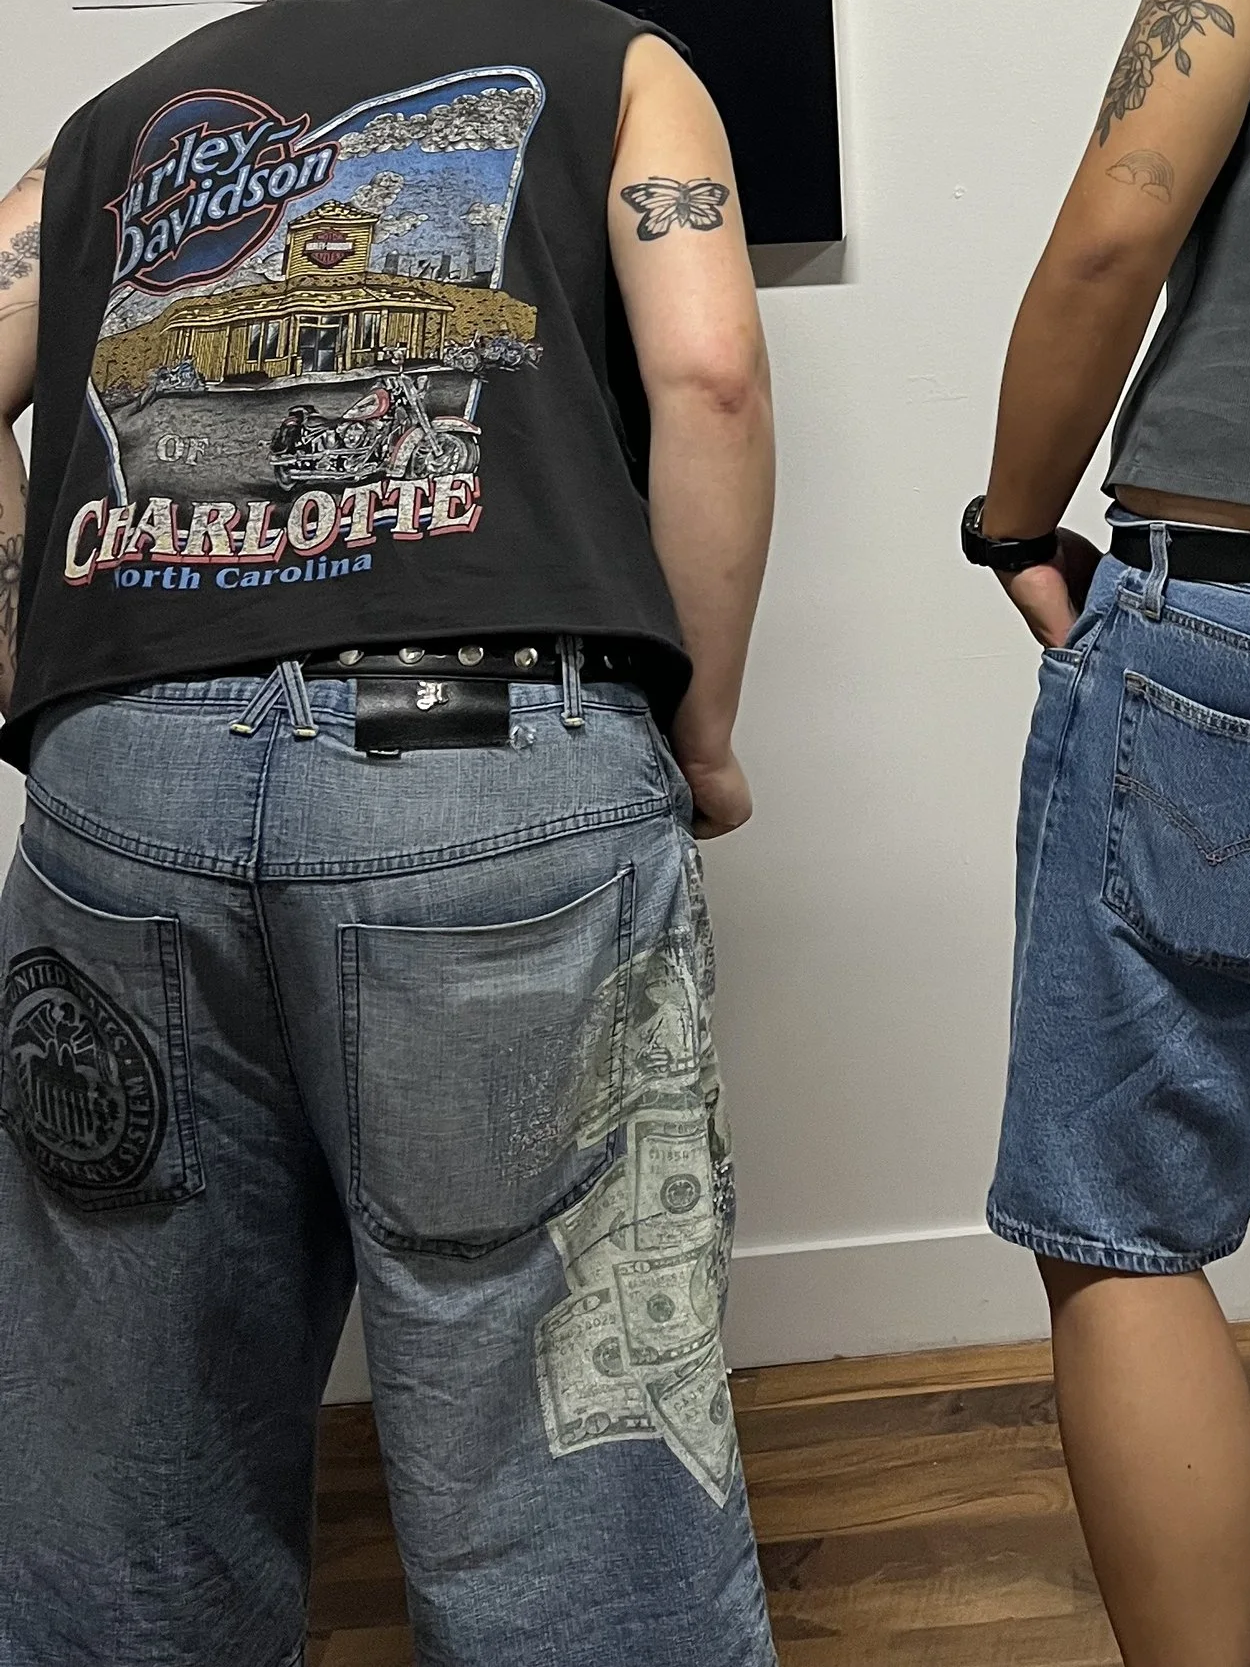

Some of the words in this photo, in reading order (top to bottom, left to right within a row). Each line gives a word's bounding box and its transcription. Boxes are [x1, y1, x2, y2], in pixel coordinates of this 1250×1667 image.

[113, 148, 332, 284] Davidson
[155, 433, 210, 466] OF
[63, 472, 481, 585] CHARLOTTE
[114, 566, 201, 590] orth
[215, 553, 373, 590] Carolina
